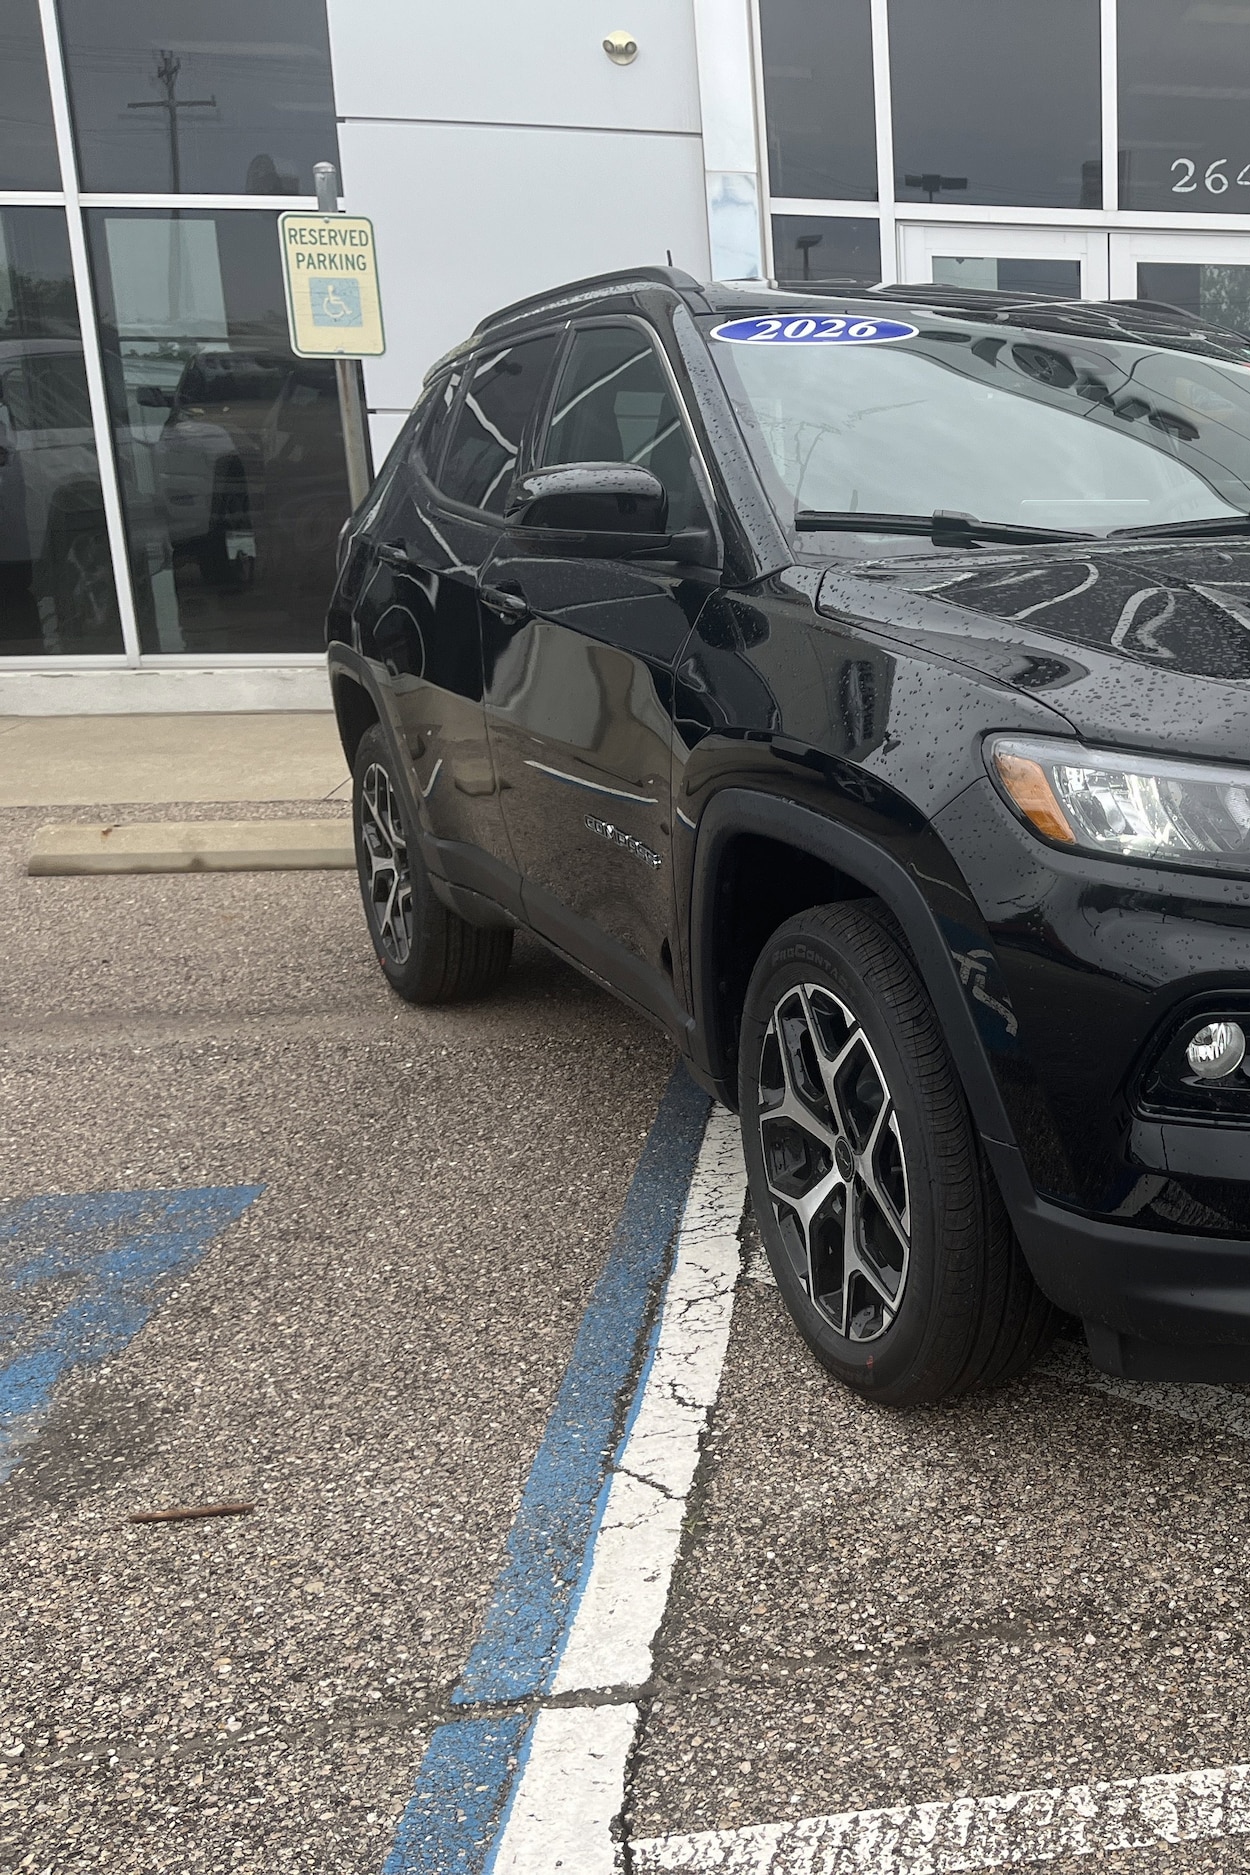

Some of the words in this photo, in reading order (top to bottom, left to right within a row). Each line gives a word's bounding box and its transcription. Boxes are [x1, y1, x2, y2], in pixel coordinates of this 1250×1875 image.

[288, 227, 369, 247] RESERVED
[296, 252, 367, 271] PARKING
[747, 319, 882, 341] 2026
